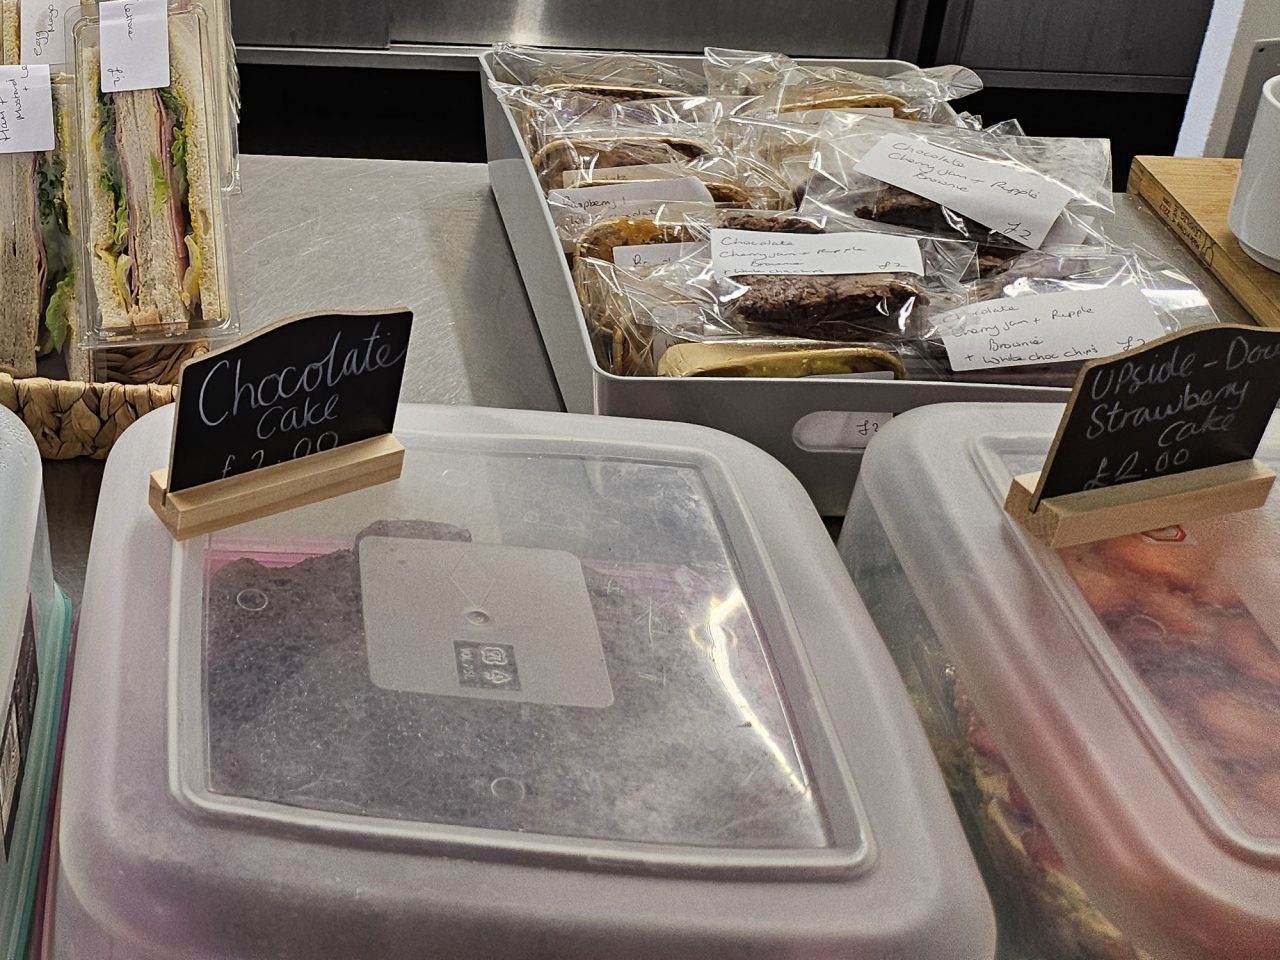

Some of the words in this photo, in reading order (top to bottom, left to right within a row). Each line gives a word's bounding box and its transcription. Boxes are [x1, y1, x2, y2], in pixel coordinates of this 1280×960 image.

[891, 141, 966, 169] Chocolate
[1003, 221, 1032, 241] £2
[198, 321, 408, 427] Chocolate
[1086, 379, 1251, 440] Strawberry
[1083, 448, 1190, 491] £2.00
